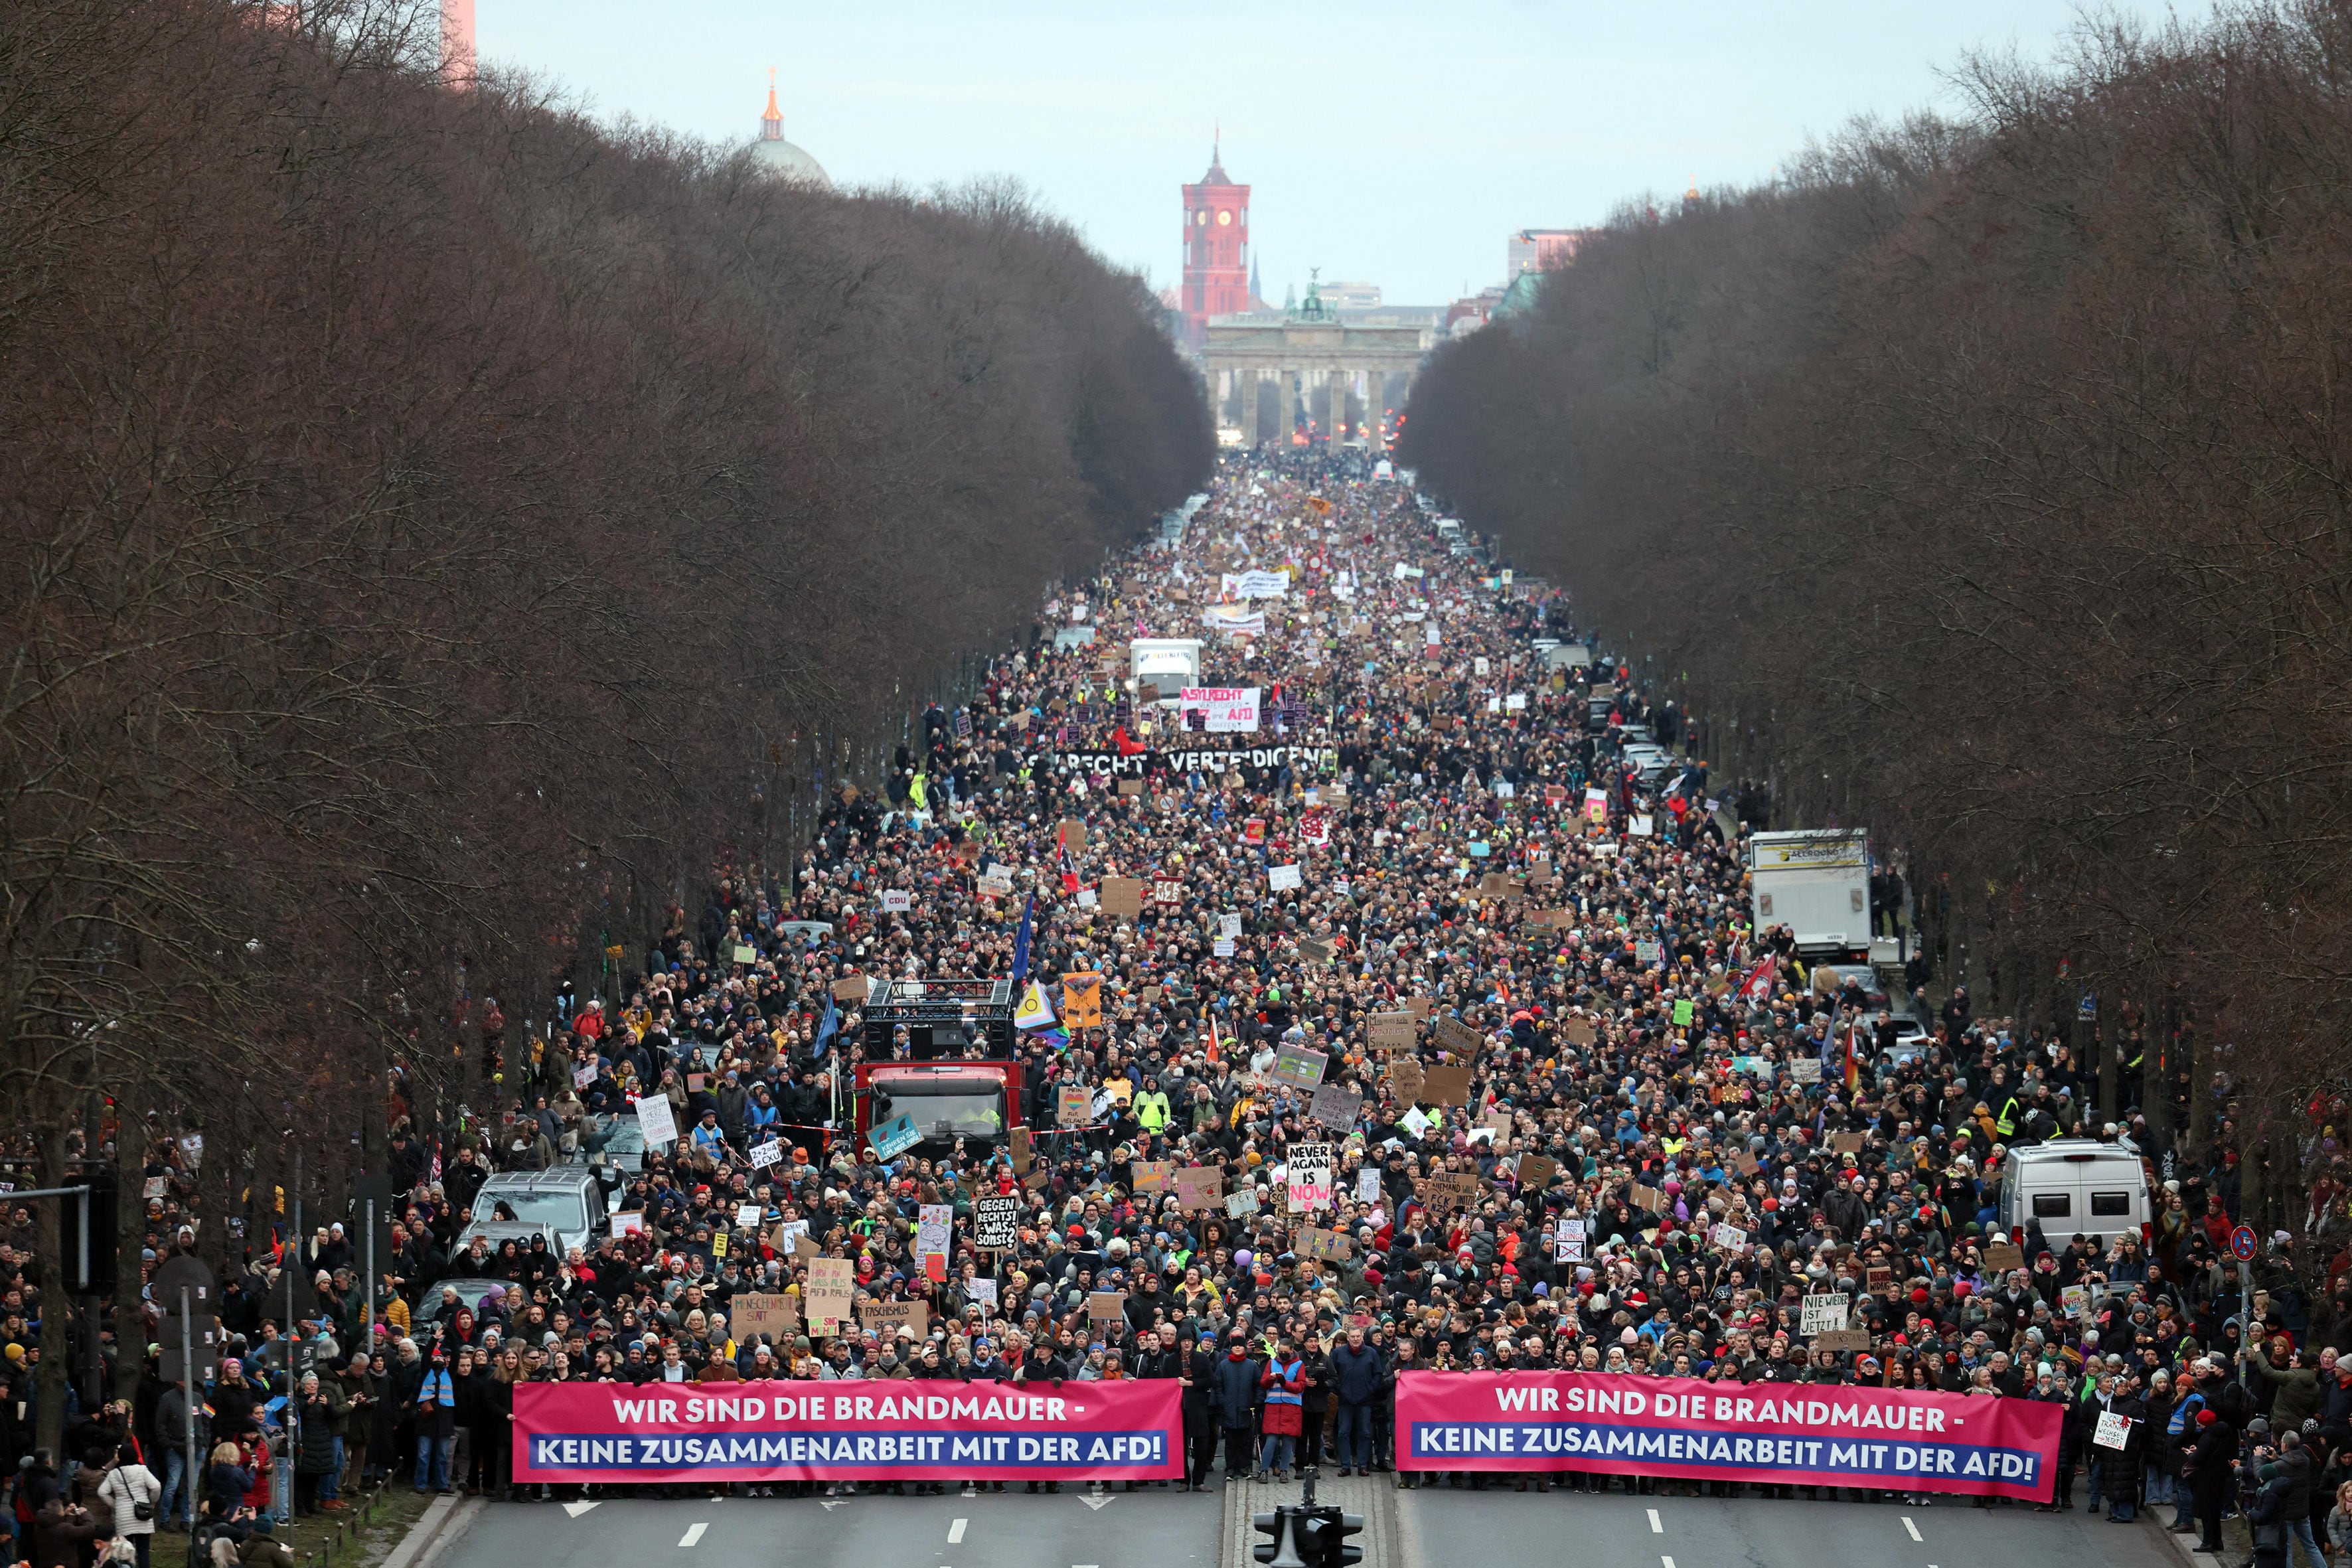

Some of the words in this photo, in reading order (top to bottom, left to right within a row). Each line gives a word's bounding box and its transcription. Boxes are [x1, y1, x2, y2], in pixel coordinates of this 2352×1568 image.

[1180, 688, 1243, 701] ASYLRECHT
[1228, 708, 1253, 720] AFD
[1156, 881, 1180, 893] FCK
[1156, 892, 1178, 902] NZS
[647, 1108, 662, 1119] MERZ
[882, 1135, 905, 1152] KEHREN
[905, 1129, 917, 1138] SIE
[751, 1144, 777, 1160] 2+2=4
[761, 1151, 781, 1165] CXU
[1290, 1146, 1328, 1158] NEVER
[1291, 1158, 1329, 1171] AGAIN
[1302, 1172, 1315, 1184] IS
[1290, 1185, 1330, 1202] NOW
[979, 1199, 1015, 1212] GEGEN
[1230, 1194, 1251, 1206] FCK
[1431, 1194, 1451, 1206] FCK
[1431, 1203, 1449, 1214] NZS
[977, 1211, 1017, 1226] RECHTS!
[831, 1279, 847, 1287] AUS
[1870, 1282, 1890, 1292] WIDRIG
[810, 1288, 827, 1297] AFD
[830, 1289, 850, 1298] RAUS
[1804, 1296, 1824, 1308] NIE
[1826, 1294, 1848, 1307] WIEDER
[746, 1310, 768, 1322] STATT
[866, 1304, 910, 1318] FASCHISMUS
[1804, 1310, 1821, 1320] IST
[824, 1317, 838, 1326] SIND
[874, 1319, 884, 1330] IST
[1801, 1320, 1832, 1334] JETZT
[613, 1399, 679, 1423] WIR
[685, 1398, 765, 1423] SIND
[774, 1397, 826, 1421] DIE
[834, 1396, 1067, 1421] BRANDMAUER
[1495, 1387, 1560, 1411] WIR
[1566, 1387, 1646, 1415] SIND
[1654, 1393, 1706, 1420] DIE
[1715, 1397, 1945, 1433] BRANDMAUER
[2109, 1415, 2121, 1424] CDU
[2098, 1427, 2124, 1441] WECHSEL
[538, 1439, 633, 1464] KEINE
[640, 1437, 945, 1463] ZUSAMMENARBEIT
[951, 1437, 1010, 1461] MIT
[1018, 1437, 1081, 1461] DER
[1087, 1436, 1160, 1461] AFD!
[1421, 1427, 1514, 1452] KEINE
[1522, 1427, 1823, 1466] ZUSAMMENARBEIT
[1829, 1443, 1889, 1470] MIT
[1895, 1447, 1956, 1474] DER
[1962, 1451, 2034, 1481] AFD!
